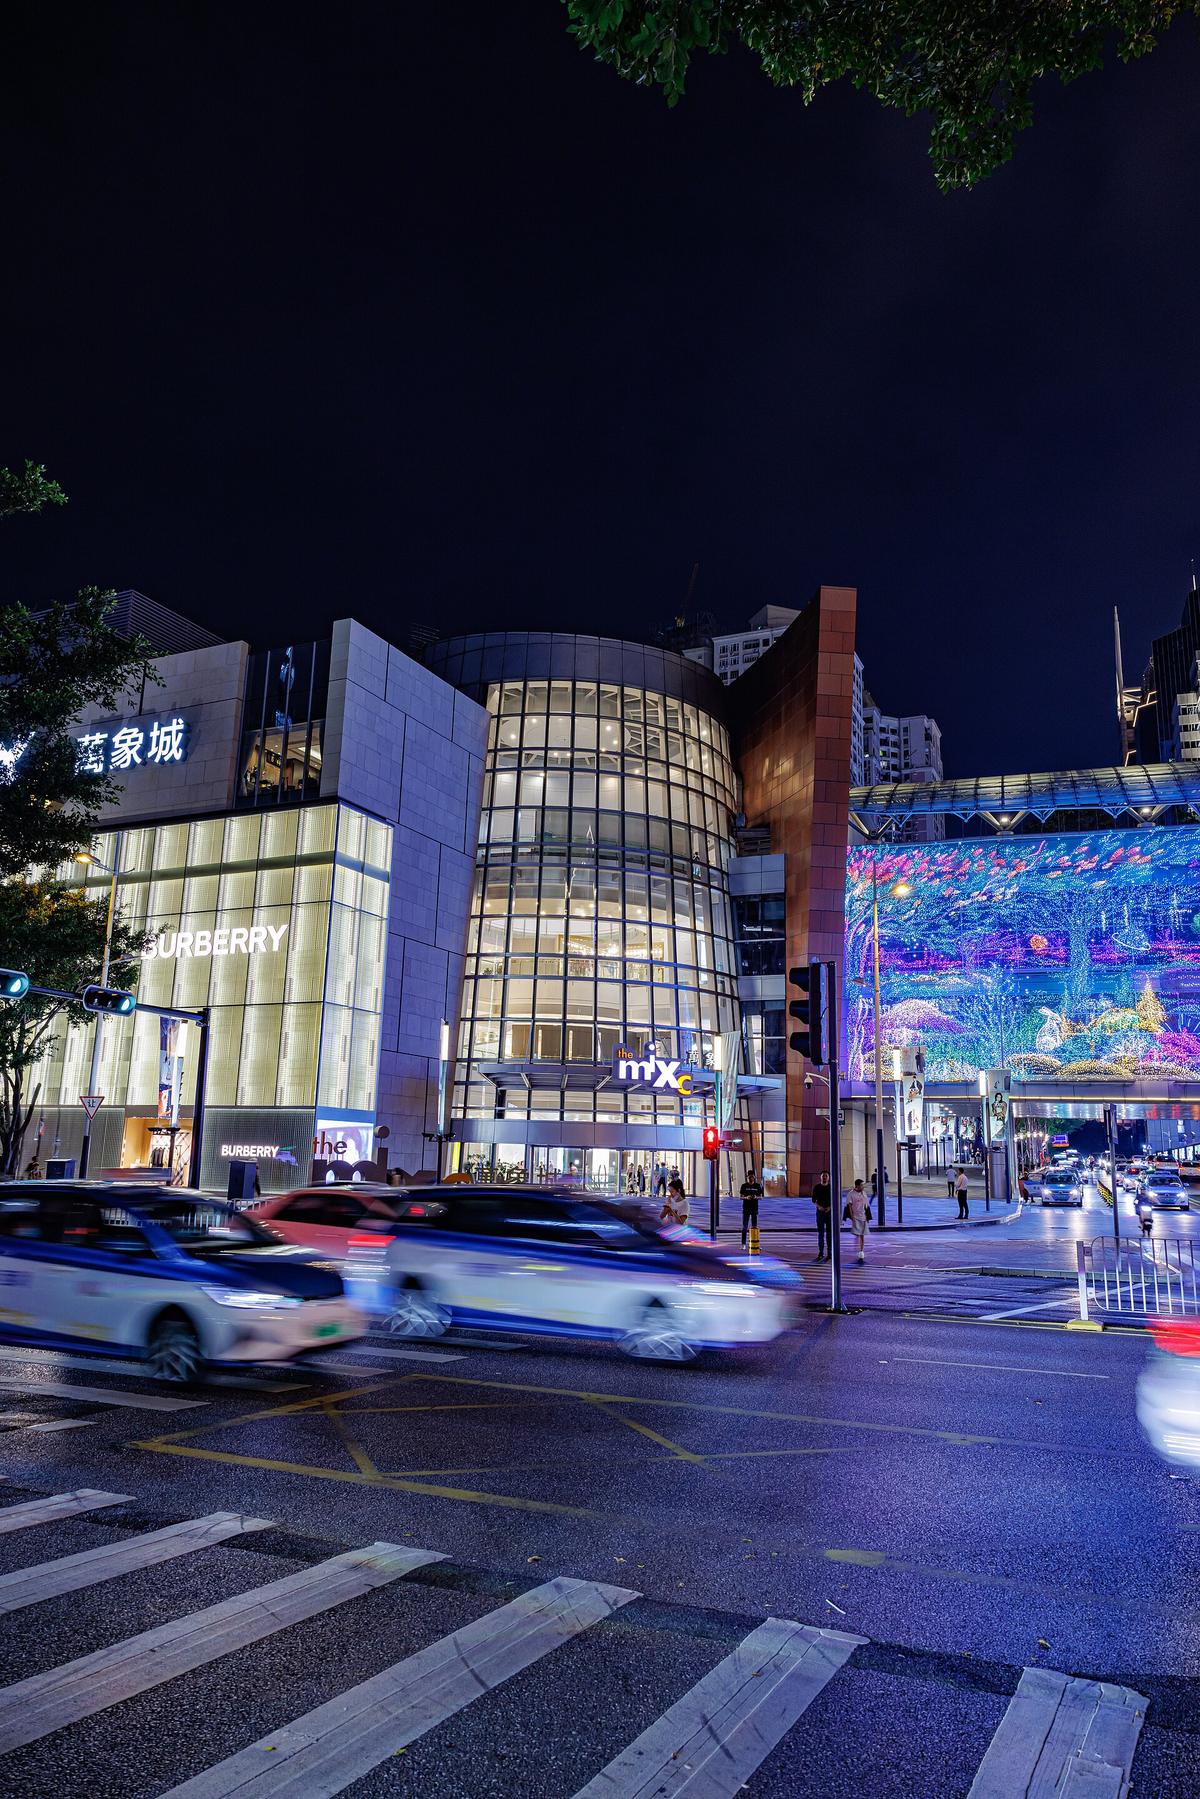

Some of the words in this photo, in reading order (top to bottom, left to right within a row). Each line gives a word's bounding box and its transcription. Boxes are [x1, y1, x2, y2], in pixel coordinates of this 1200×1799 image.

[141, 925, 288, 960] BURBERRY
[618, 1048, 633, 1059] the
[221, 1144, 280, 1158] BURBERRY
[312, 1131, 348, 1155] the
